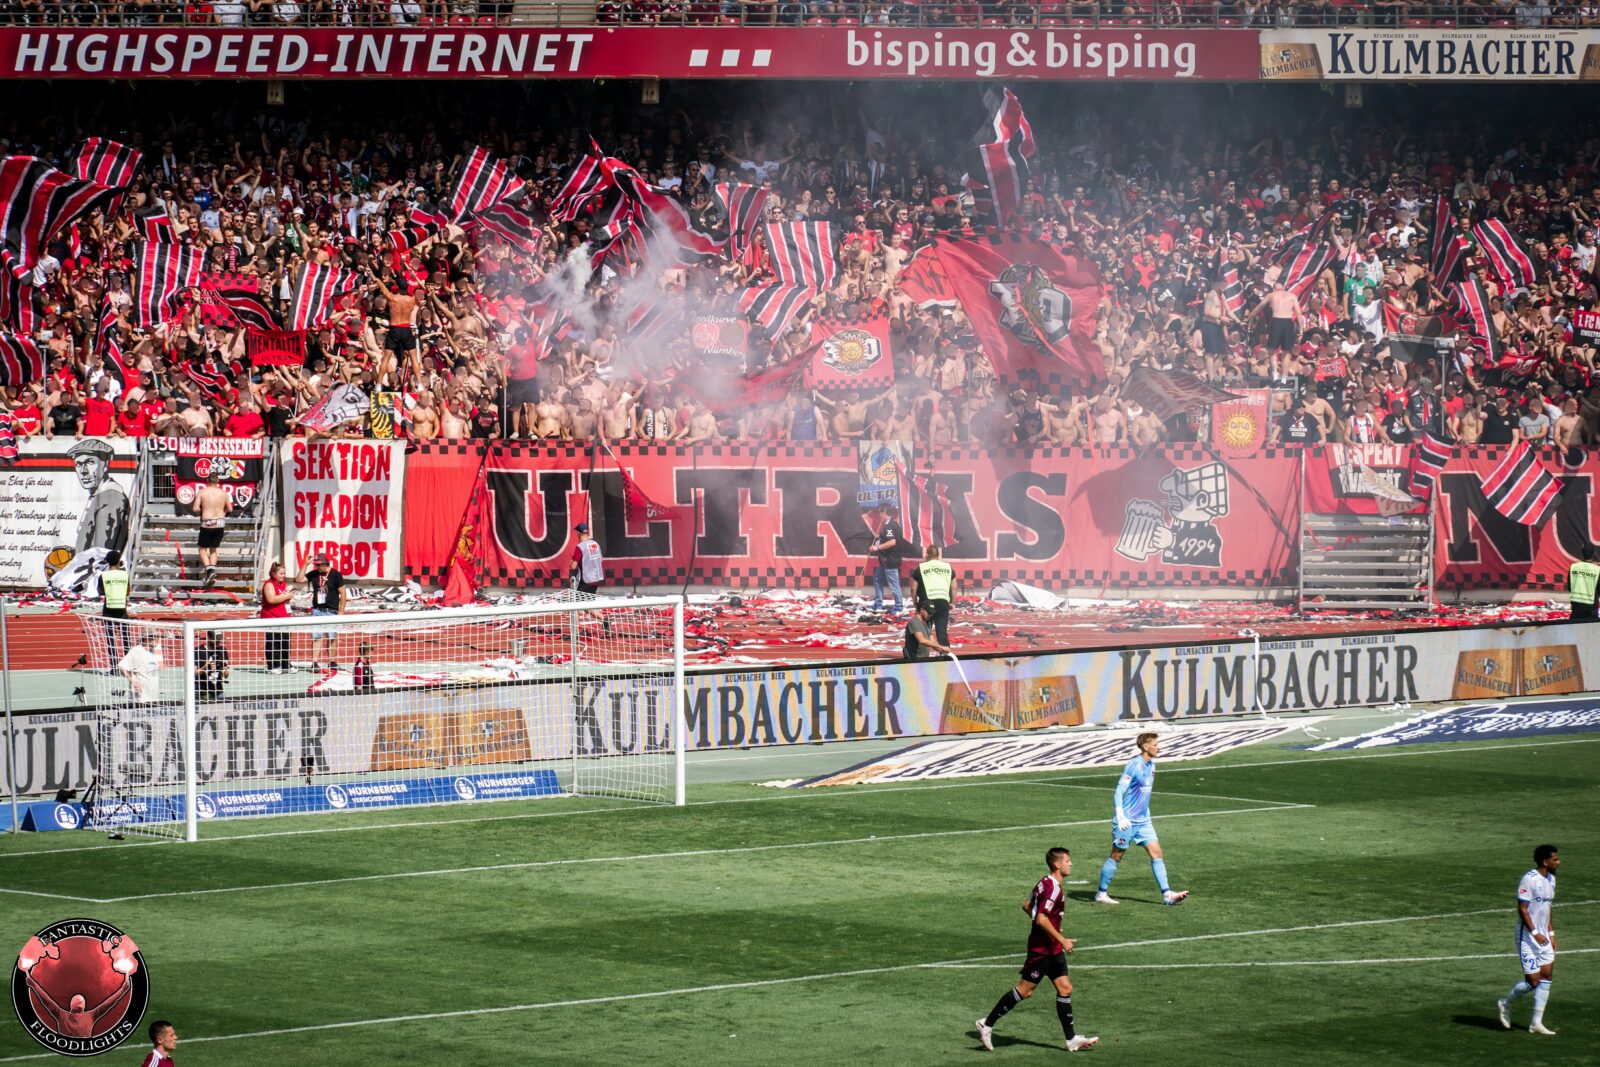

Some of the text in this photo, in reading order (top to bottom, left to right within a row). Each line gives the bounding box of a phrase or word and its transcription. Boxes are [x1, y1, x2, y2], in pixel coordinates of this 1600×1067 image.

[14, 33, 594, 73] HIGHSPEED-INTERNET
[847, 30, 1196, 77] bisping & bisping
[1328, 33, 1576, 75] KULMBACHER
[1260, 58, 1317, 78] KULMBACHER
[179, 437, 263, 456] DIE BESESSENEN
[1333, 442, 1402, 466] RESPEKT
[292, 441, 391, 481] SEKTION
[37, 477, 54, 487] diese
[294, 492, 388, 531] STADION
[1177, 535, 1216, 555] 1994
[1175, 645, 1231, 656] KULMBACHER BIER
[1259, 640, 1314, 651] KULMBACHER BIER
[1341, 635, 1396, 646] KULMBACHER BIER
[725, 671, 786, 683] KULMBACHER BIER
[816, 666, 876, 678] KULMBACHER BIER
[1119, 645, 1419, 720] KULMBACHER
[1458, 667, 1513, 694] KULMBACHER
[1523, 665, 1579, 692] KULMBACHER
[571, 676, 903, 755] KULMBACHER
[1017, 697, 1078, 724] KULMBACHER
